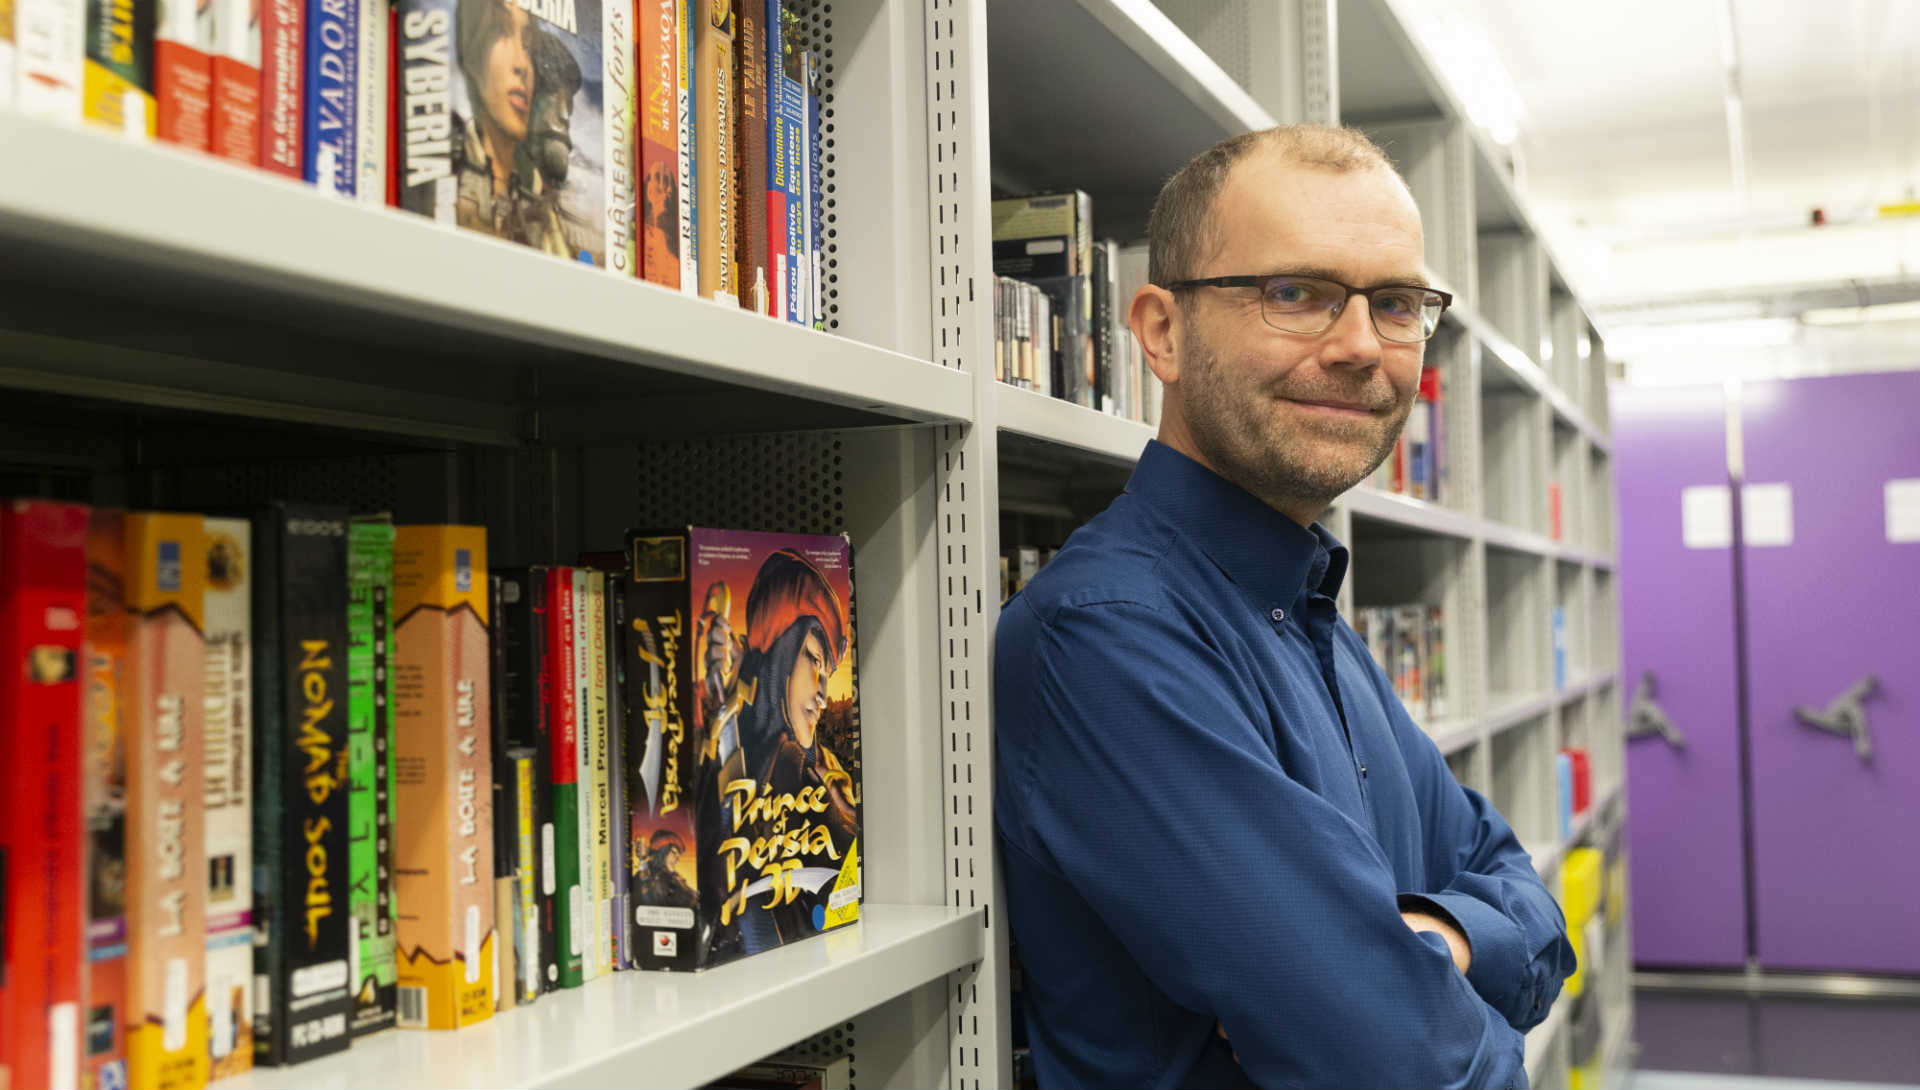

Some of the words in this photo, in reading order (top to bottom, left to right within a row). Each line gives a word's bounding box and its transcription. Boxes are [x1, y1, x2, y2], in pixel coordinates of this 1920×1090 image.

[607, 7, 629, 101] forts
[660, 0, 674, 96] VOYAGE
[743, 16, 755, 89] TALMUD
[404, 9, 452, 187] SYBERIA
[717, 67, 728, 165] DISPARUES
[744, 94, 756, 118] LE
[679, 94, 690, 240] RELIGIONS
[774, 117, 785, 187] Dictionnaire
[786, 123, 797, 195] Equateur
[794, 171, 802, 196] des
[809, 132, 820, 194] ballons
[607, 103, 626, 272] CHÂTEAUX
[795, 200, 804, 236] pays
[811, 200, 821, 229] des
[787, 203, 797, 256] Bolivie
[788, 266, 798, 313] Pérou
[561, 589, 573, 620] plus
[563, 623, 573, 642] en
[593, 590, 604, 650] Drahos
[562, 646, 574, 706] d'amour
[594, 654, 604, 690] Tom
[656, 608, 682, 702] Prince
[296, 639, 339, 804] NOMAD
[564, 725, 574, 744] 20
[596, 708, 605, 772] Proust
[660, 715, 684, 817] Persia
[458, 768, 477, 837] BOITE
[598, 782, 607, 846] Marcel
[724, 778, 830, 834] Prince
[773, 809, 788, 834] of
[304, 816, 332, 946] SOUL
[458, 845, 478, 886] LA
[718, 819, 842, 893] Persia
[761, 858, 804, 911] 3D
